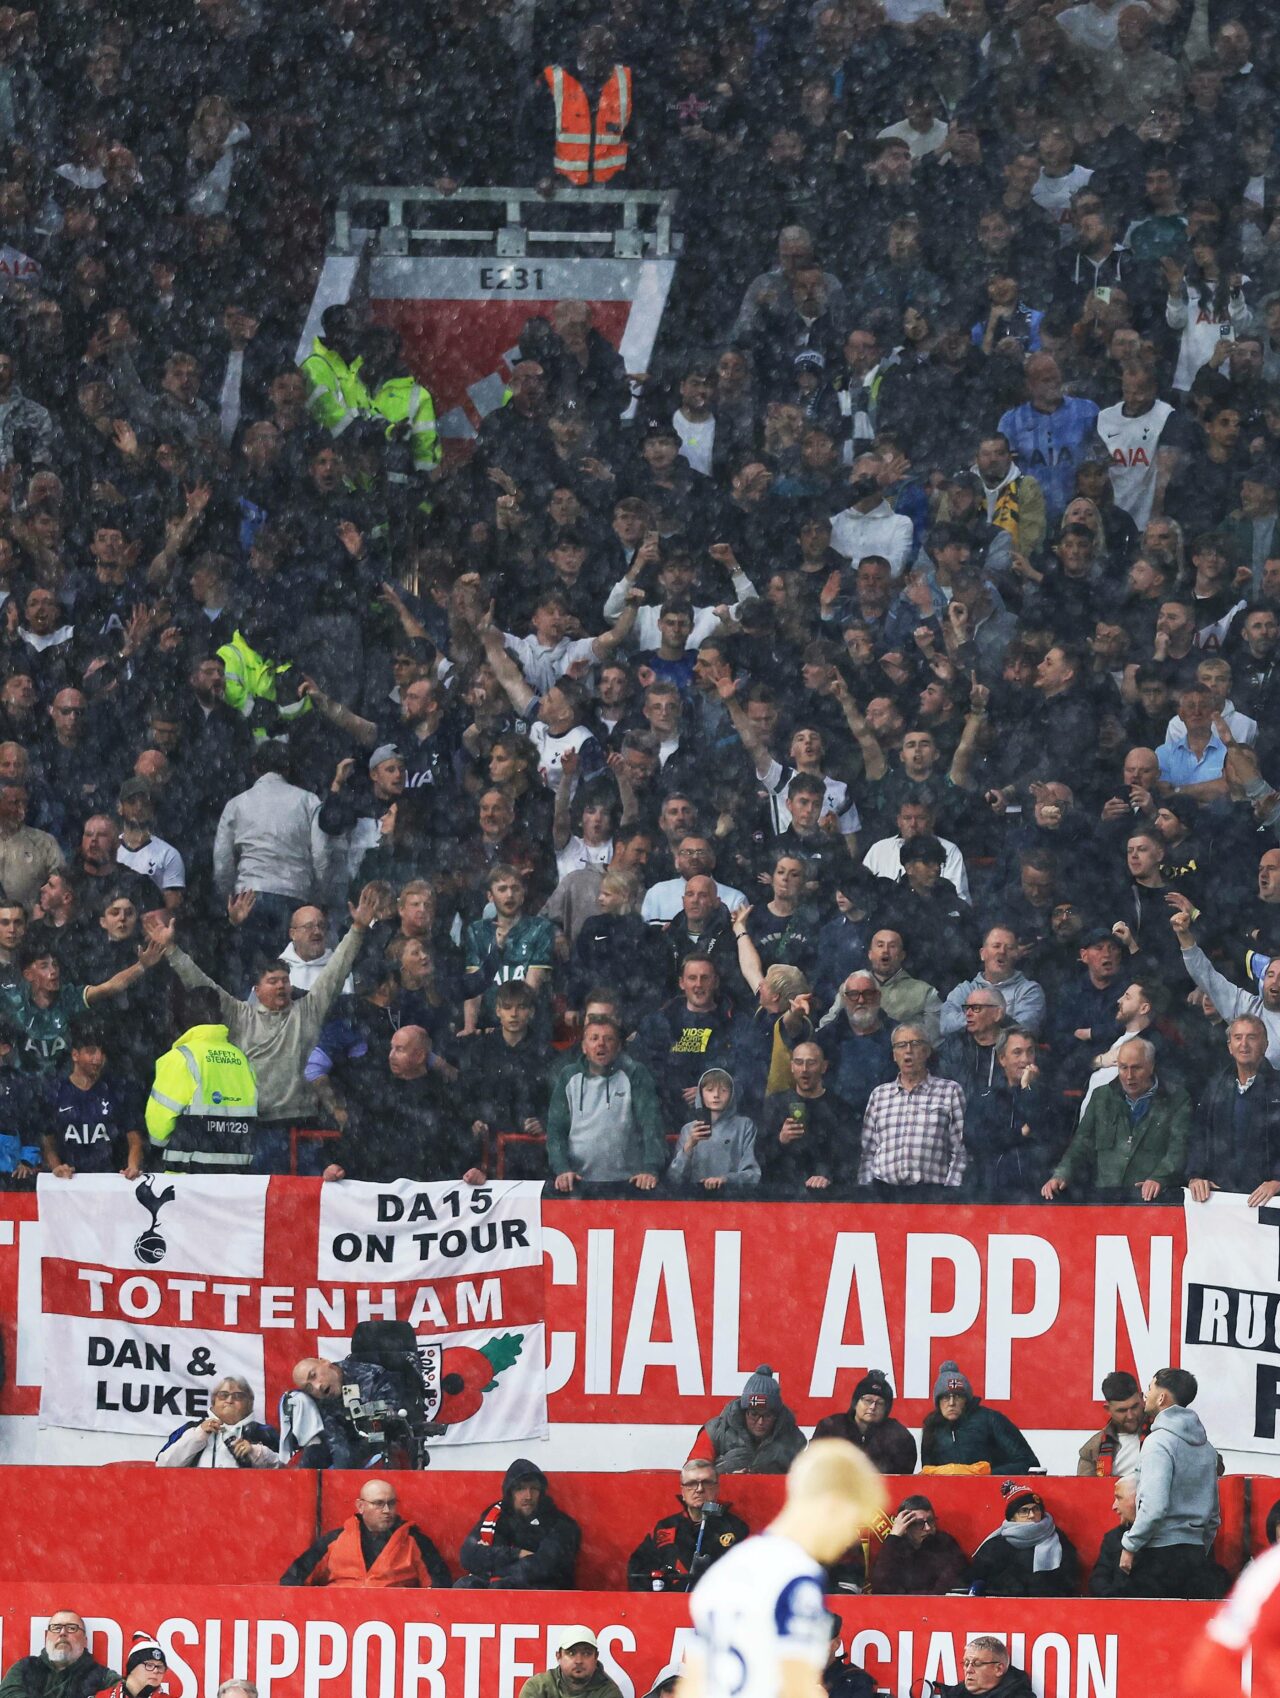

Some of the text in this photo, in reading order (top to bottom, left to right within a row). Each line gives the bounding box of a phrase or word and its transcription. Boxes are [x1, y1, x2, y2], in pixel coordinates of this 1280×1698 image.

[480, 268, 544, 290] E231
[1113, 448, 1149, 467] AIA
[25, 1037, 66, 1057] AIA
[208, 1050, 236, 1058] SAFETY
[206, 1056, 242, 1065] STEWARD
[65, 1123, 111, 1144] AIA
[207, 1121, 249, 1134] IPM1229
[377, 1187, 493, 1222] DA15
[332, 1219, 530, 1263] ON TOUR
[78, 1268, 501, 1330] TOTTENHAM
[809, 1231, 1061, 1400] APP
[87, 1336, 218, 1376] DAN &
[96, 1379, 209, 1417] LUKE
